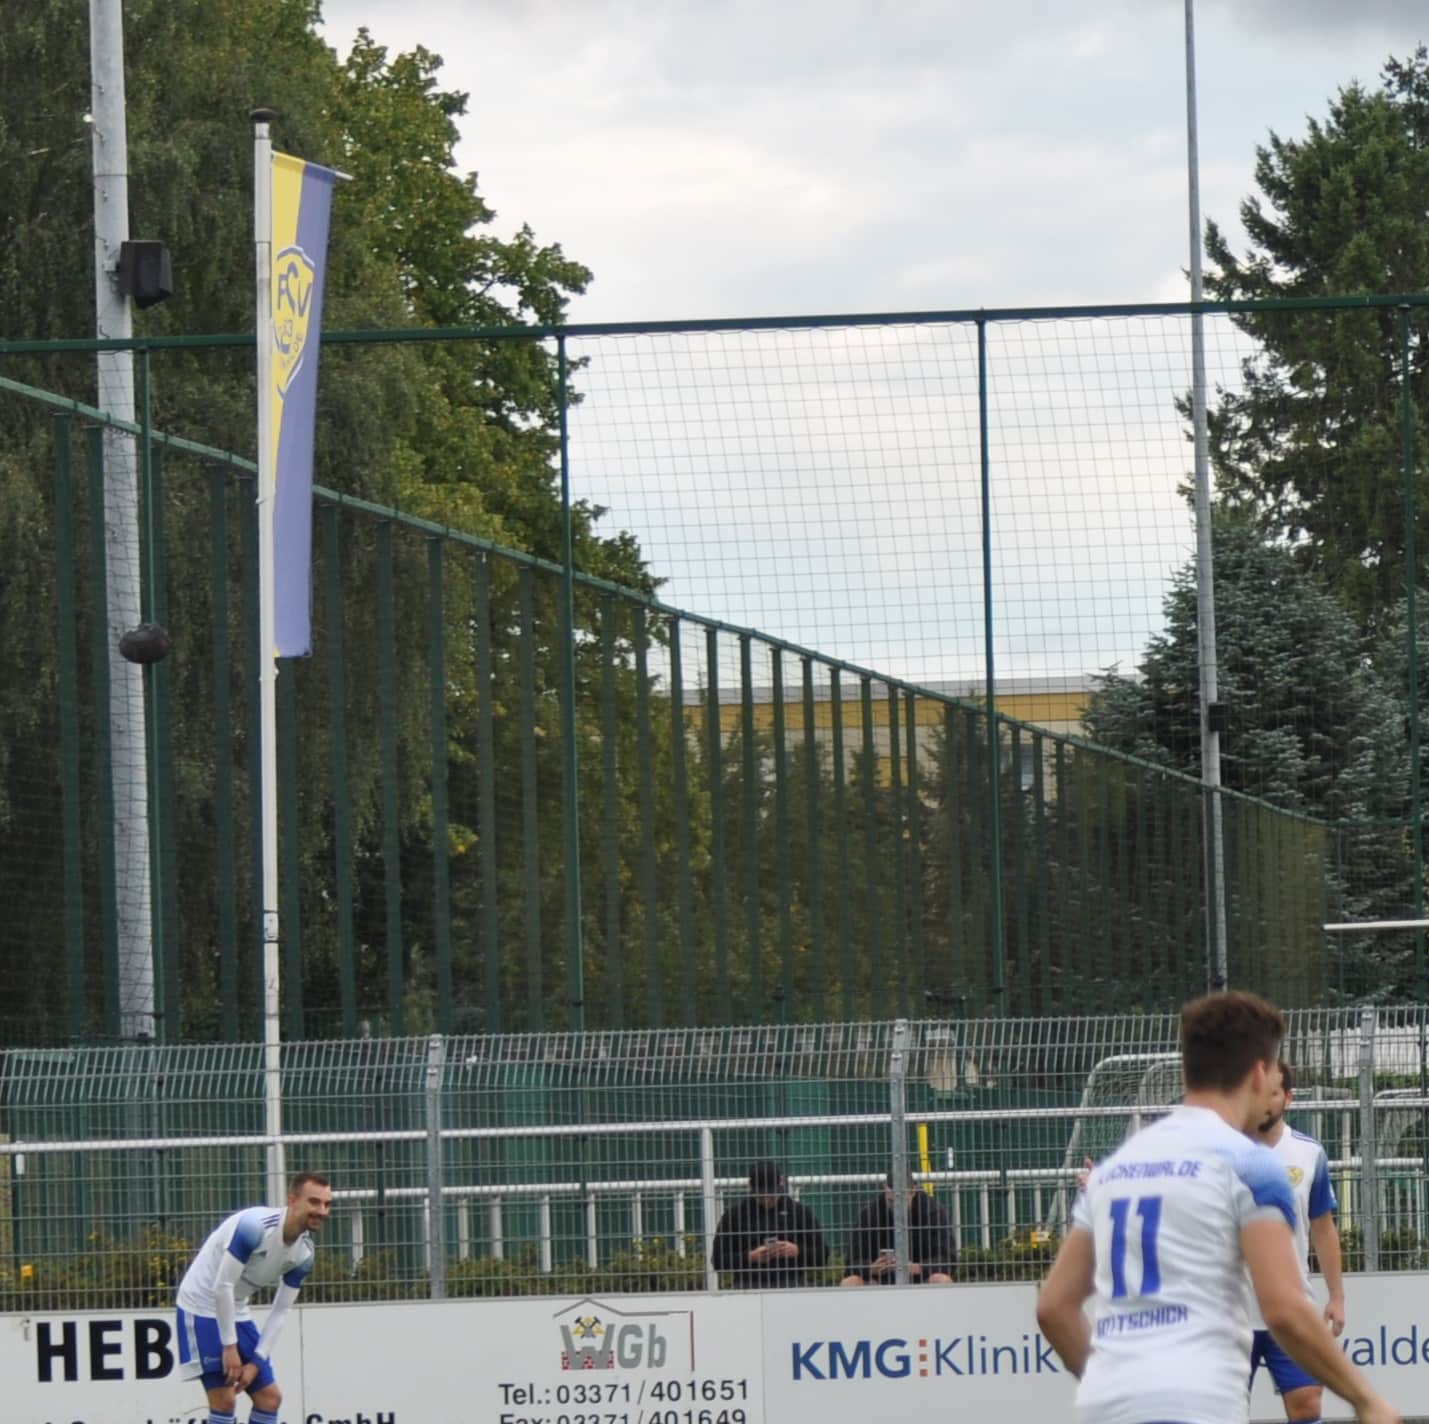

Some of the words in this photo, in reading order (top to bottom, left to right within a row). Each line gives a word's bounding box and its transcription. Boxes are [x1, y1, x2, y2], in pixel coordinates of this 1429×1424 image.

[1110, 1195, 1163, 1299] 11
[791, 1338, 911, 1381] KMG
[498, 1383, 551, 1406] Tel.:
